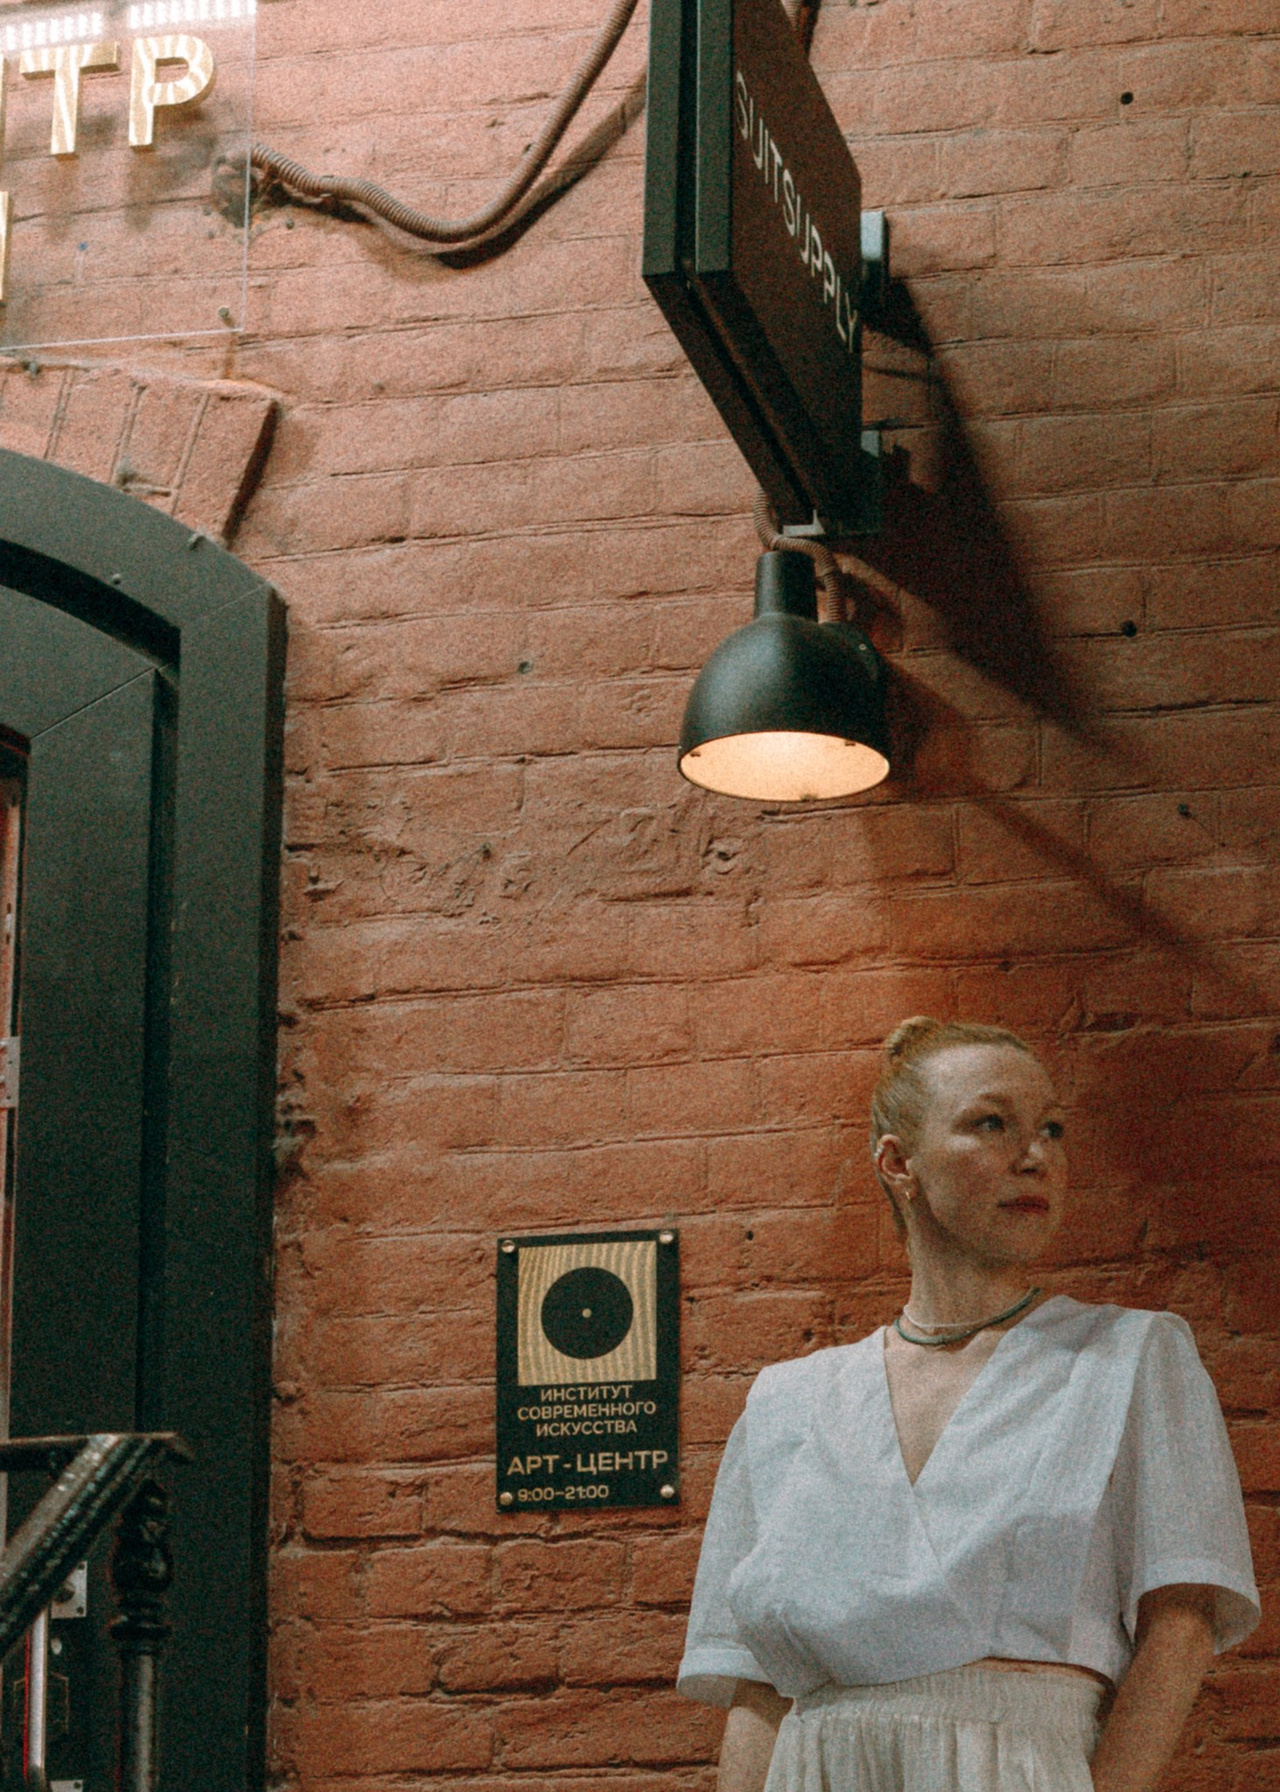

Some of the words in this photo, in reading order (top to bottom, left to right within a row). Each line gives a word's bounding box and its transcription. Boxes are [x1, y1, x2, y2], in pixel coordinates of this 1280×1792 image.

[0, 34, 216, 158] ТР
[736, 70, 858, 353] SUITSUPPLY
[540, 1385, 633, 1402] ИНСТИТУТ
[517, 1401, 656, 1420] СОВРЕМЕННОГО
[536, 1420, 638, 1437] ИСКУССТВА
